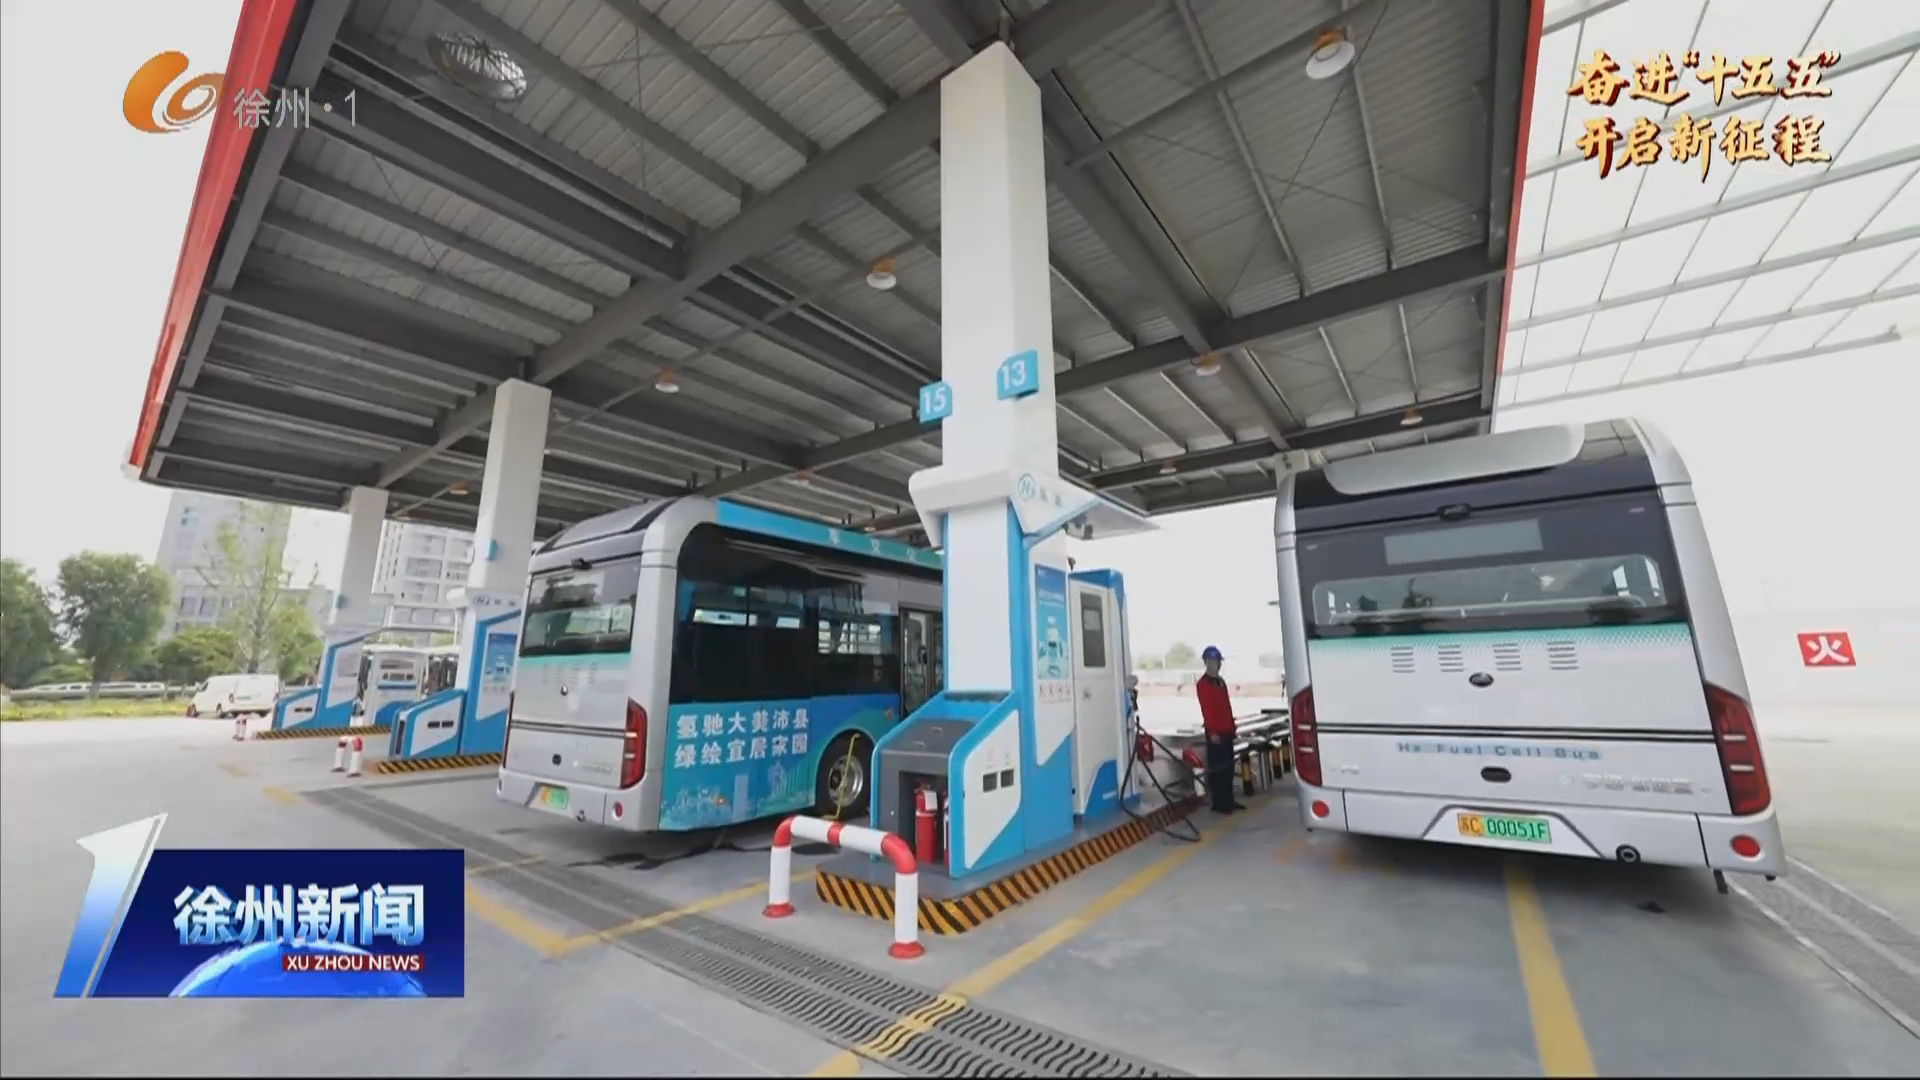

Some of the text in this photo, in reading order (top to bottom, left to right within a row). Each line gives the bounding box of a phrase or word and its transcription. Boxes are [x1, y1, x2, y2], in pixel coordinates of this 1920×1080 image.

[1001, 359, 1026, 390] 13
[924, 386, 946, 413] 15
[1805, 634, 1850, 663] 火
